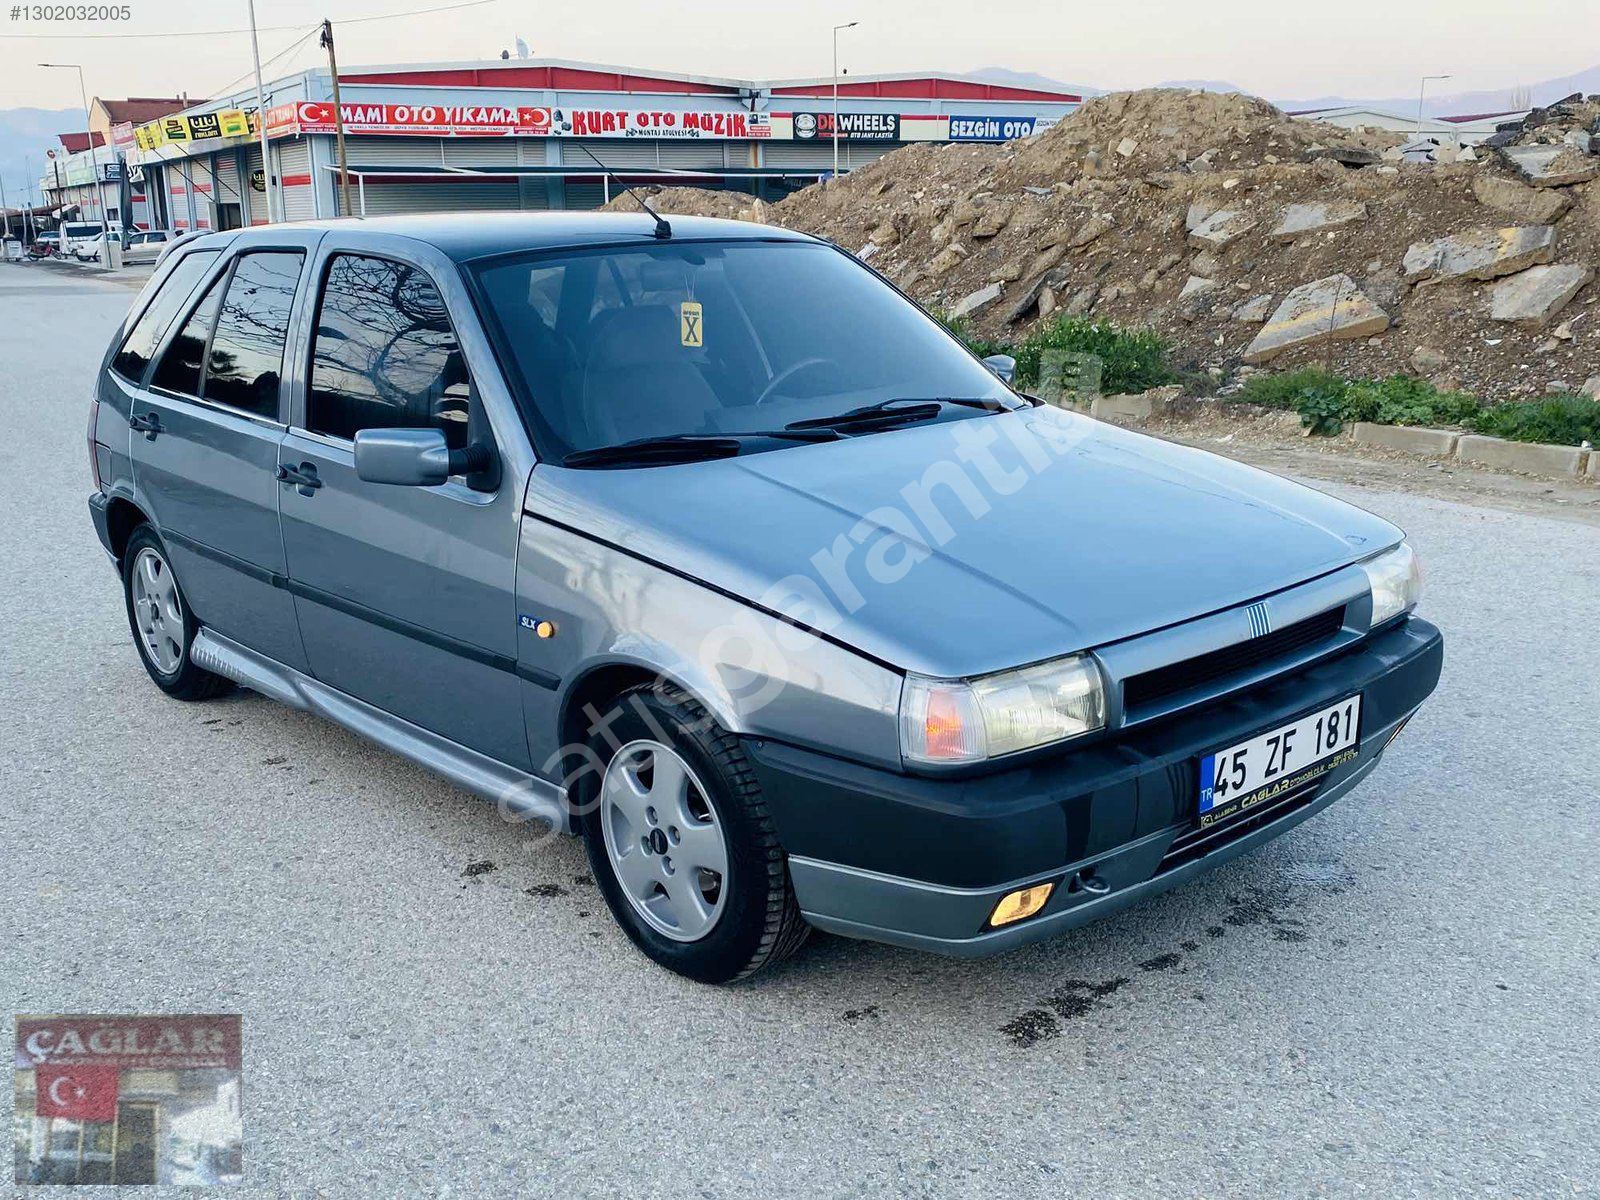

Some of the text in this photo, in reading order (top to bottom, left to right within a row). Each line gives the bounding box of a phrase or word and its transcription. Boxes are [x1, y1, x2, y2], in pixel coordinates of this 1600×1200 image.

[341, 104, 519, 124] MAMİ OTO YIKAMA
[572, 110, 629, 135] KURT
[636, 112, 675, 127] OTO
[839, 115, 895, 131] WHEELS
[951, 118, 1031, 138] SEZGİN OTO
[521, 616, 536, 630] SLX
[1213, 748, 1248, 796] 45
[1264, 728, 1297, 778] ZF
[1315, 703, 1353, 756] 181
[1201, 787, 1213, 802] TR
